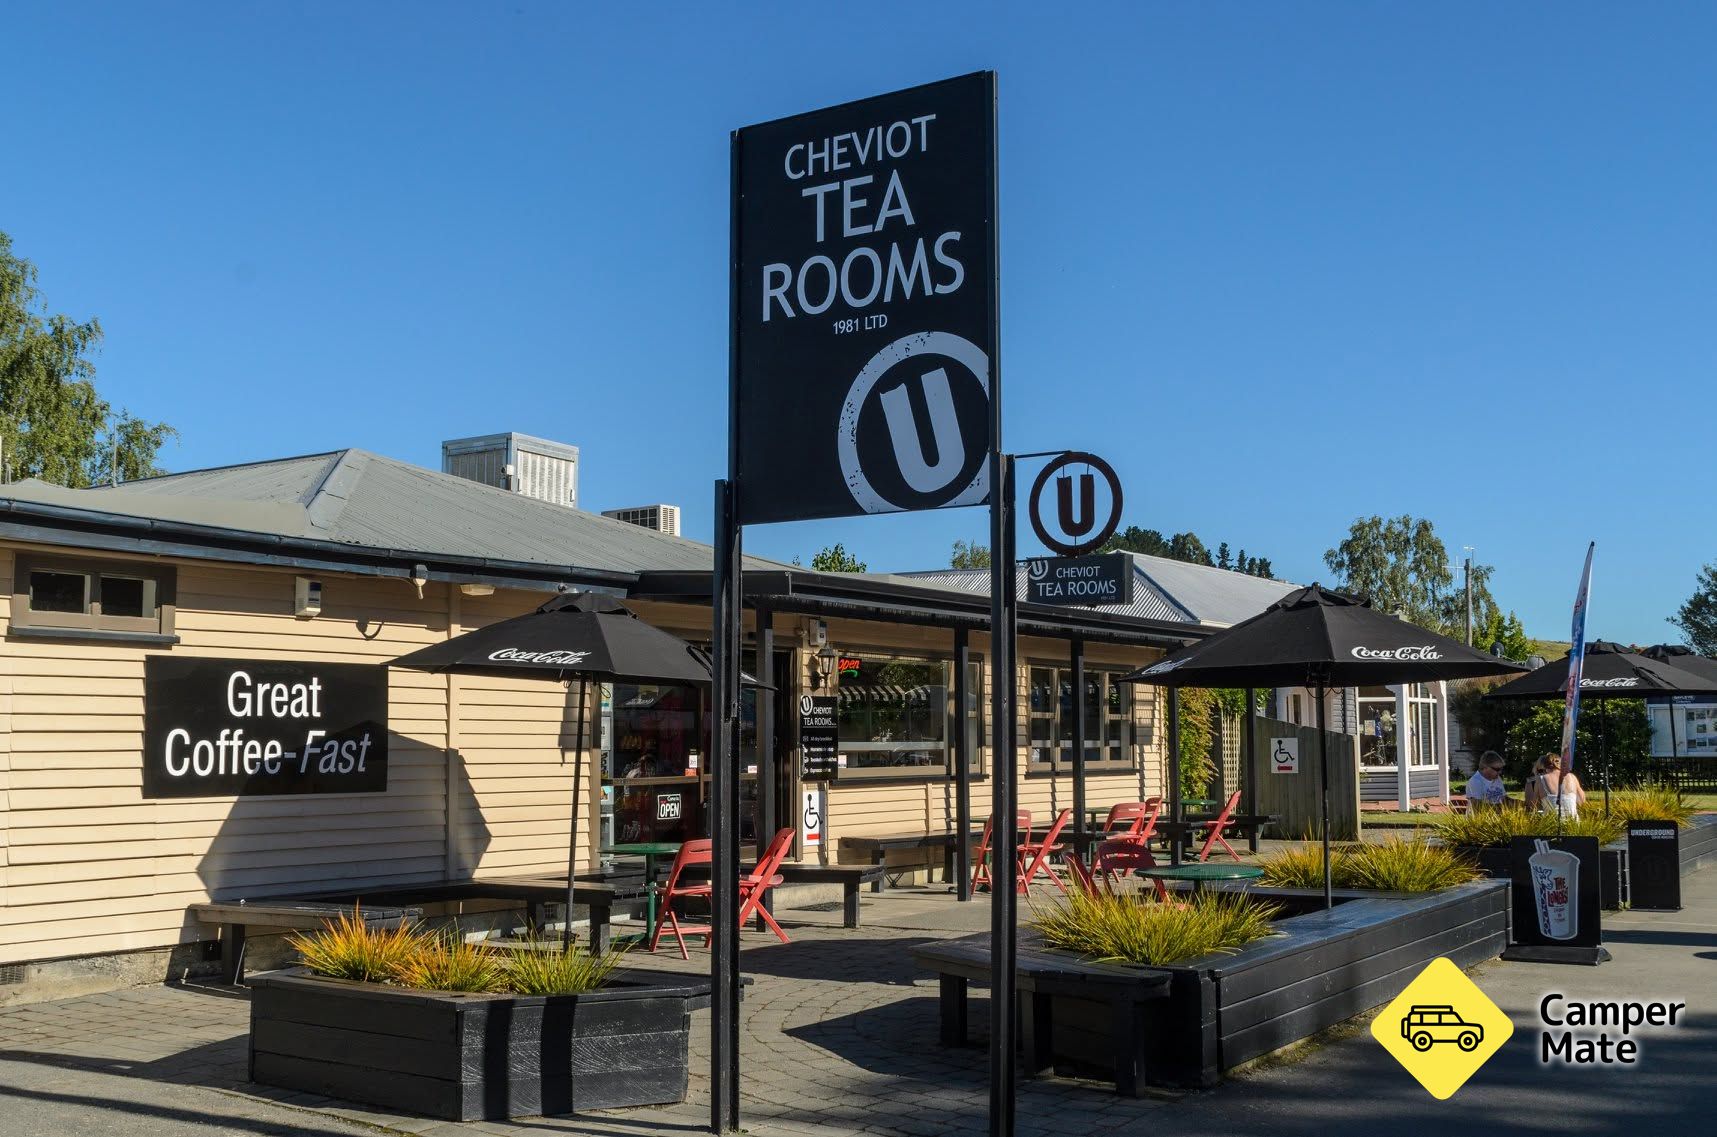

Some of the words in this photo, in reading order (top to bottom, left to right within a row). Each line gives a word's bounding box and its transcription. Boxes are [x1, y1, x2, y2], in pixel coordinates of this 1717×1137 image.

[784, 114, 937, 180] CHEVIOT
[801, 169, 916, 243] TEA
[762, 231, 965, 322] ROOMS
[833, 318, 859, 335] 1981
[865, 315, 888, 331] LTD
[879, 367, 965, 493] U
[1057, 474, 1095, 537] U
[1036, 582, 1063, 597] TEA
[1067, 579, 1116, 596] ROOMS
[1056, 566, 1101, 579] CHEVIOT
[227, 671, 322, 718] Great
[813, 706, 832, 715] CHEVIOT
[803, 717, 814, 726] TEA
[814, 717, 832, 726] ROOMS
[660, 802, 680, 818] OPEN
